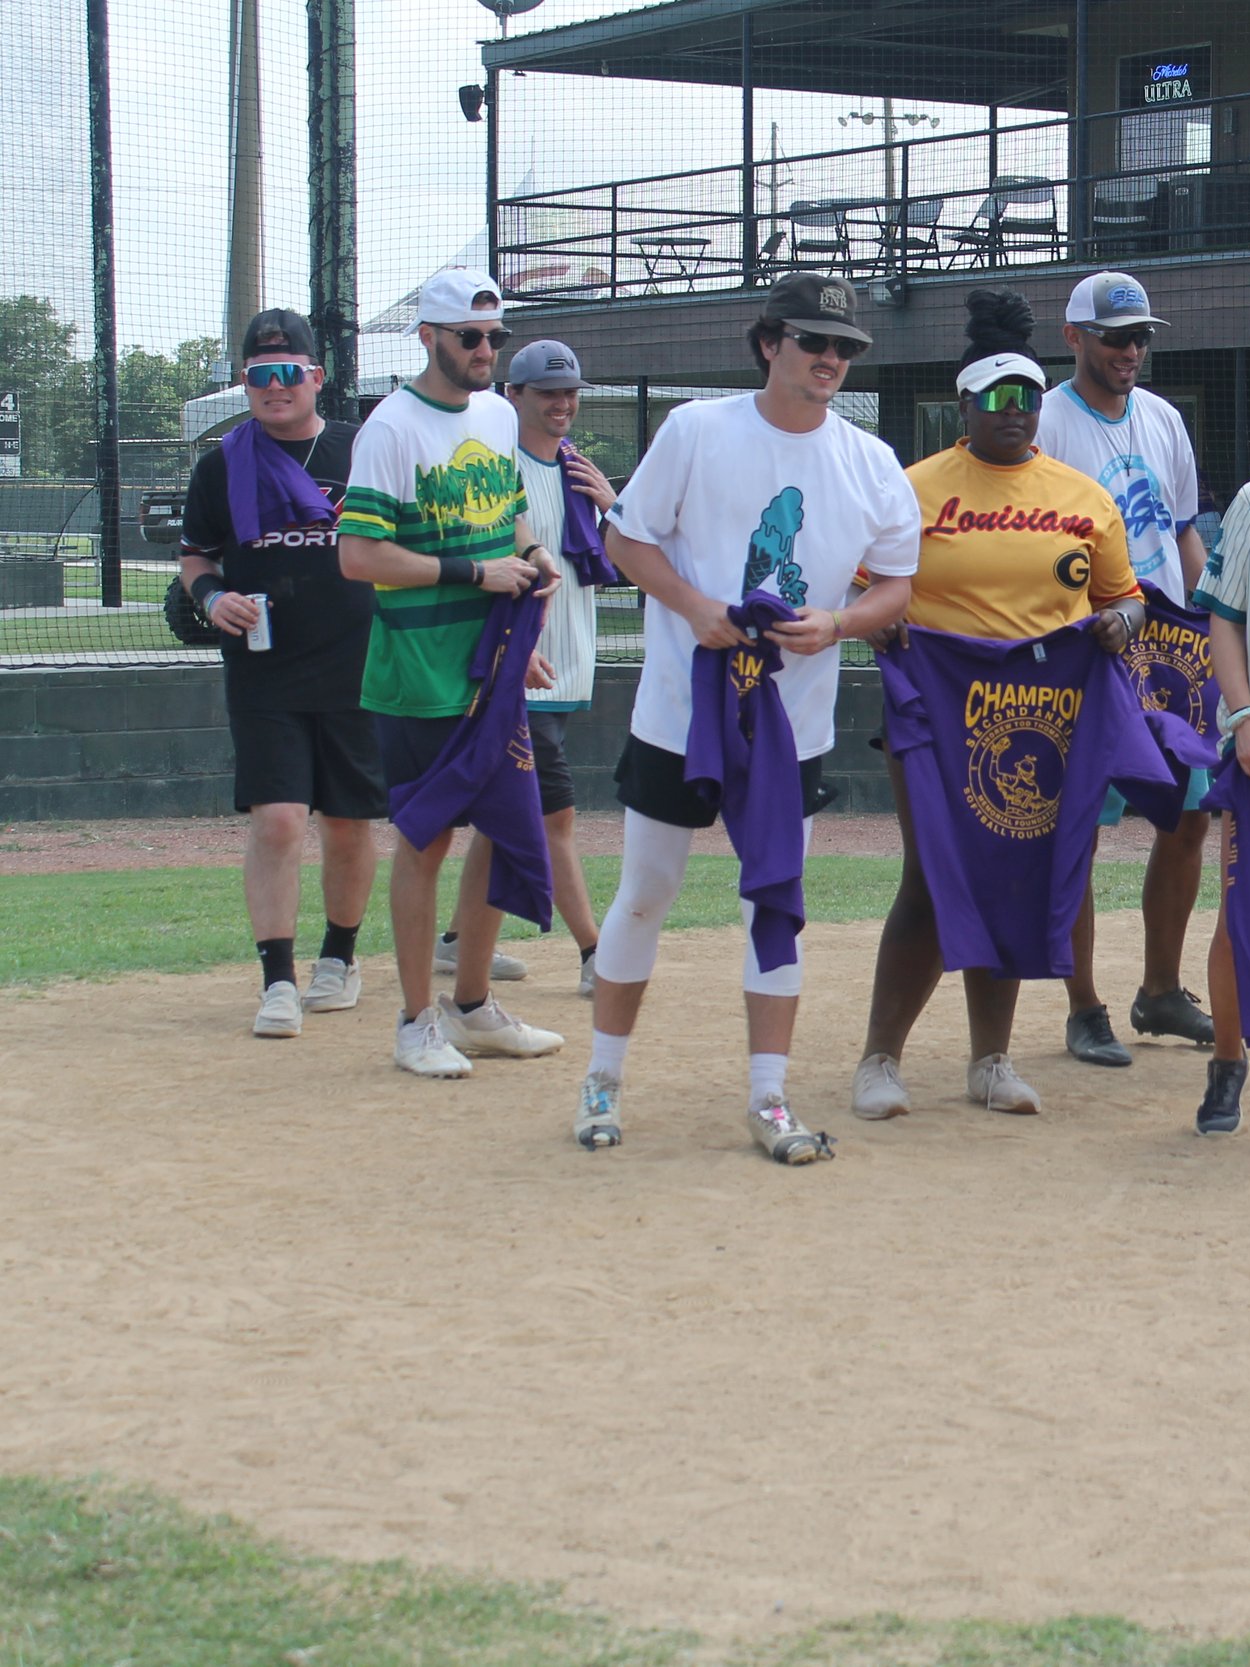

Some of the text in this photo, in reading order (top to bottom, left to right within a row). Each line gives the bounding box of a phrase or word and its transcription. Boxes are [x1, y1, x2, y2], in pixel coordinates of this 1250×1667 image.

[1144, 79, 1192, 103] ULTRA
[819, 292, 848, 309] BNB
[0, 393, 15, 411] 4
[0, 414, 18, 423] OME
[924, 496, 1095, 539] Louisiana
[1053, 549, 1090, 592] G
[965, 706, 1074, 749] SECOND ANNU
[980, 721, 1013, 749] ANDREW
[963, 786, 1056, 840] SOFTBALL TOURNA
[977, 794, 1013, 826] MEMORIAL
